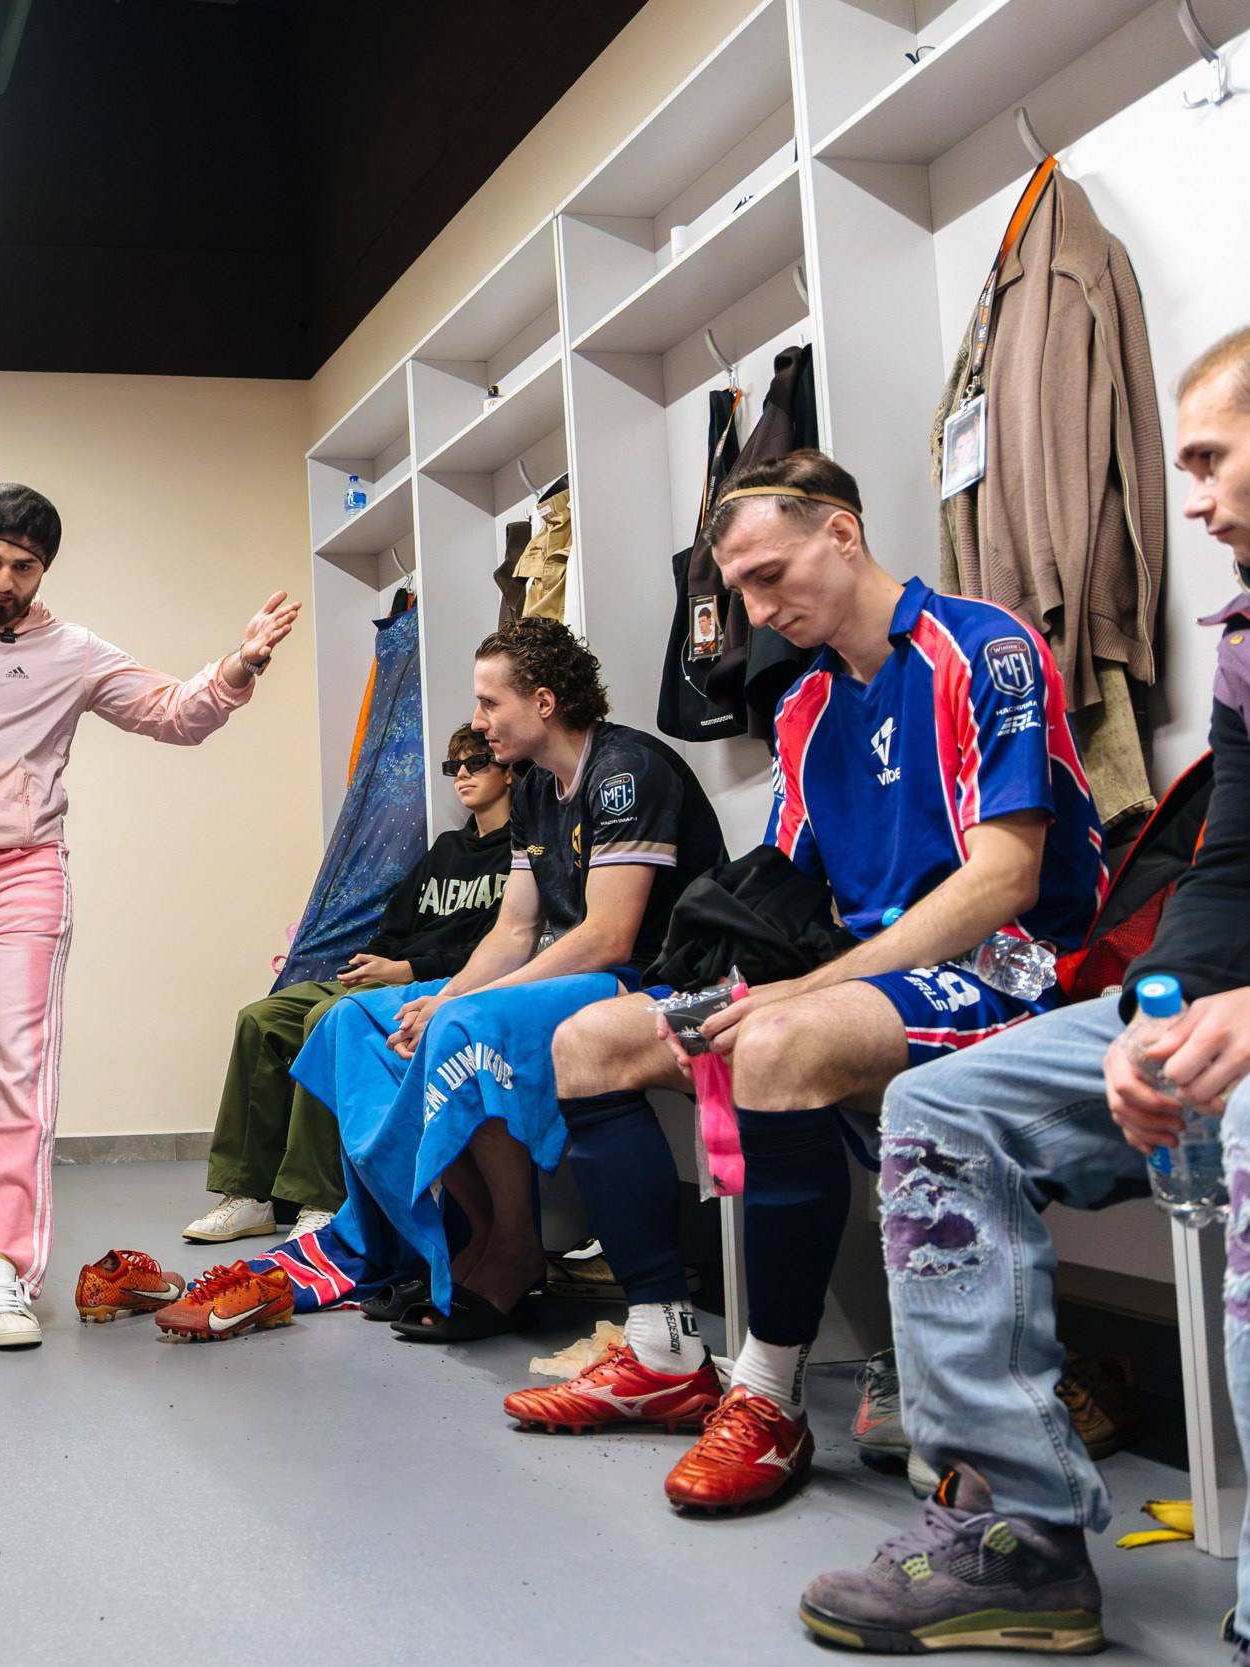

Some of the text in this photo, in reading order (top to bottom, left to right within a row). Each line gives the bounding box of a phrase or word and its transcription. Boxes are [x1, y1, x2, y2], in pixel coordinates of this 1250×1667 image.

[993, 652, 1034, 690] MFL
[603, 784, 632, 810] MFL
[903, 976, 949, 1012] ERLS
[661, 1302, 682, 1355] TAPEDESIGN
